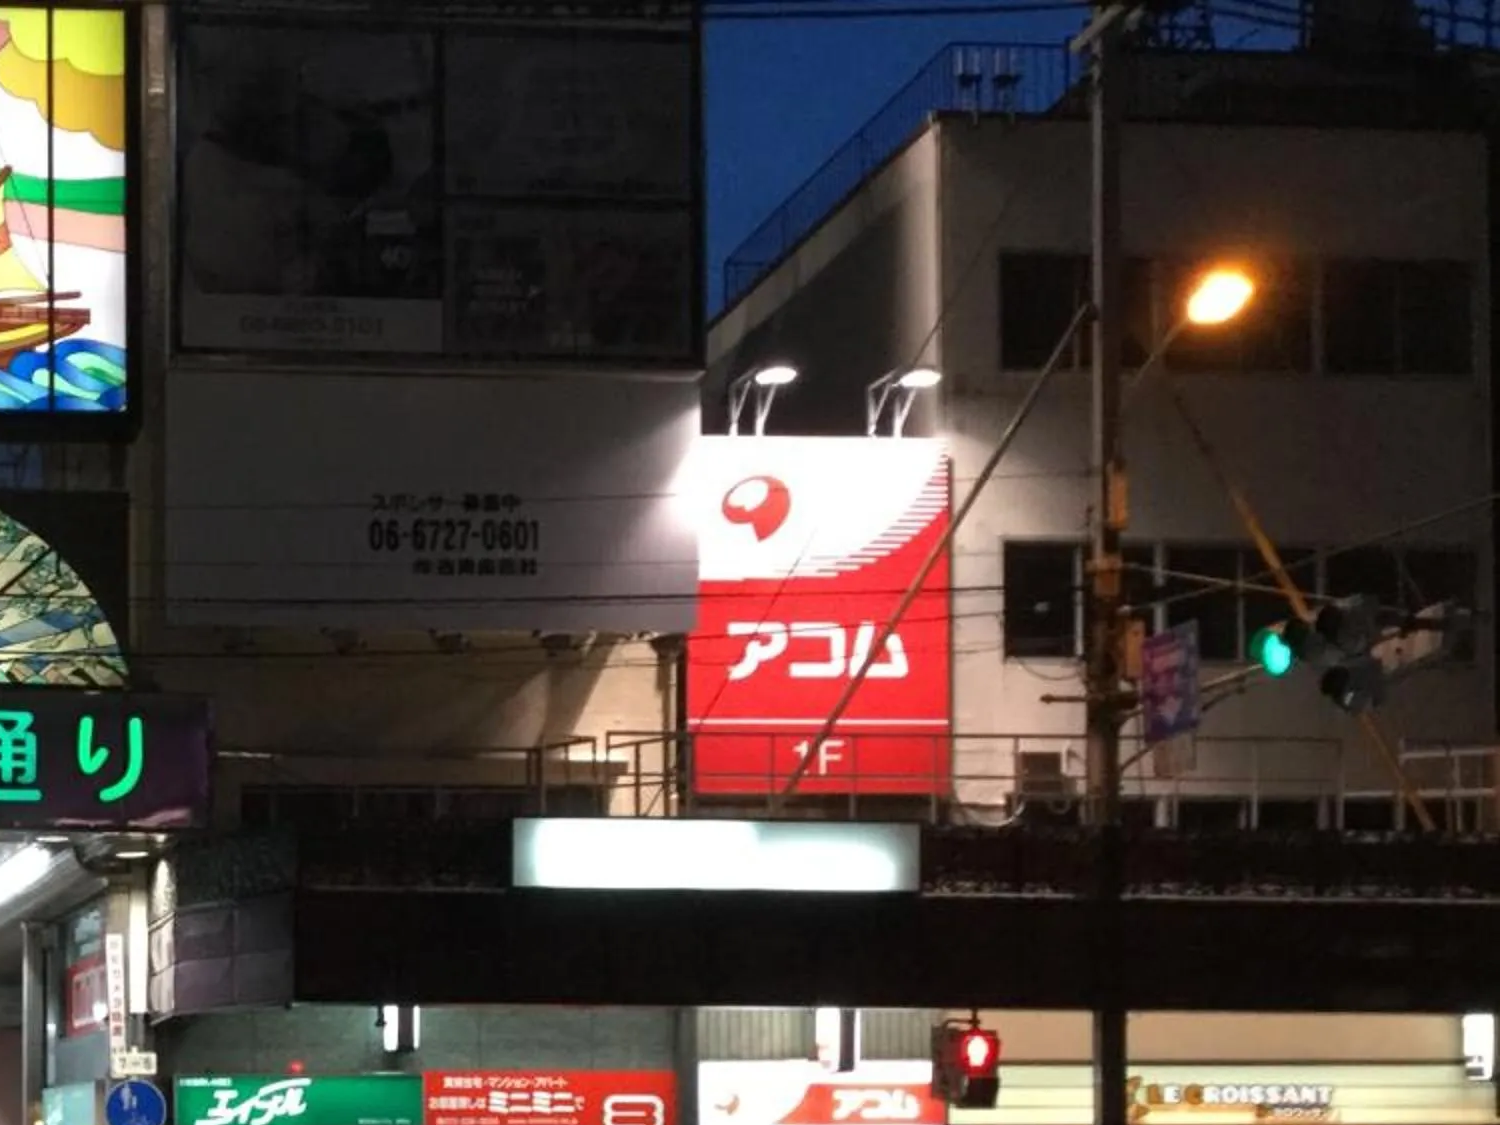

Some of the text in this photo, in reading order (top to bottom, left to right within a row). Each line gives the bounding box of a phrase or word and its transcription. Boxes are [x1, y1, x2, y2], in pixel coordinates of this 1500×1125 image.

[369, 519, 540, 552] 06-6727-0601
[726, 620, 909, 681] アコム
[832, 1089, 920, 1120] アコム
